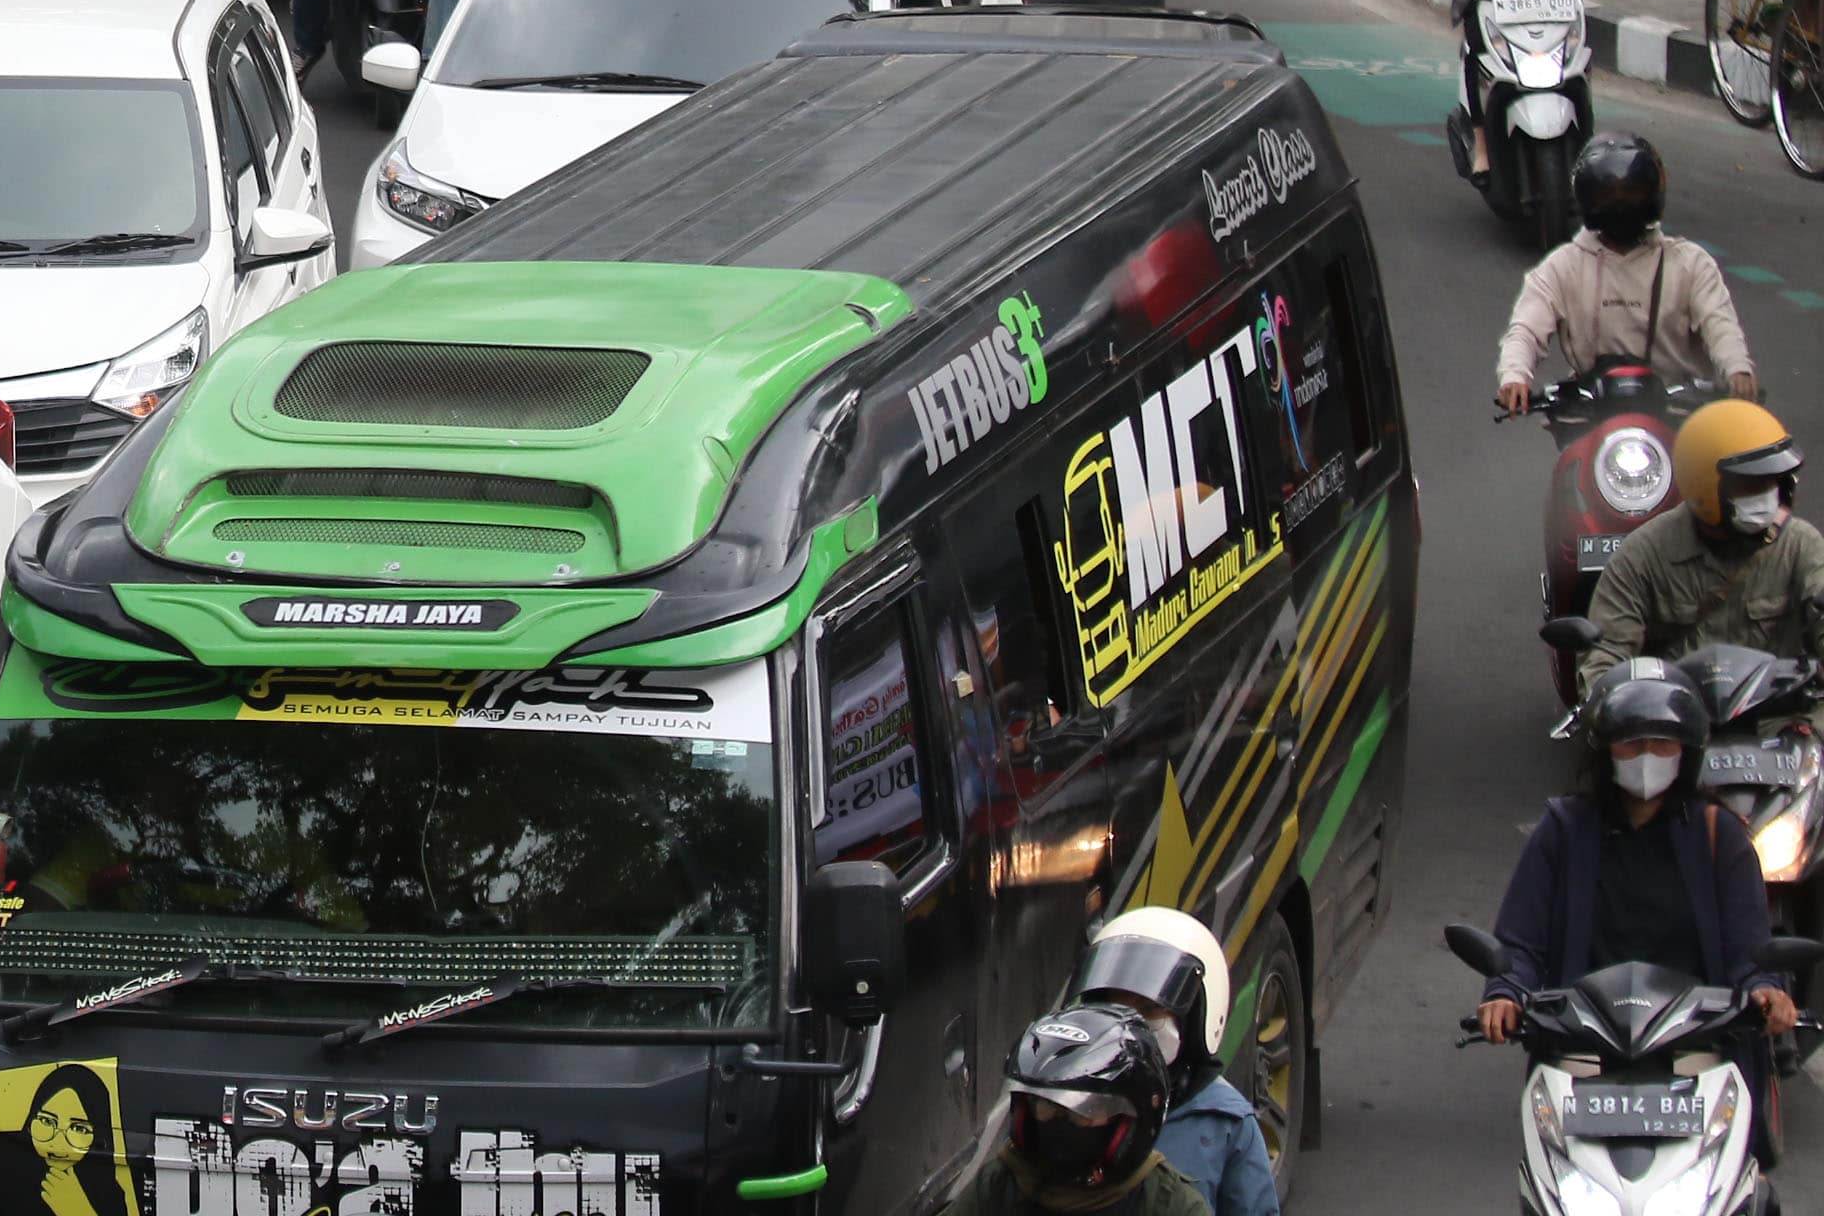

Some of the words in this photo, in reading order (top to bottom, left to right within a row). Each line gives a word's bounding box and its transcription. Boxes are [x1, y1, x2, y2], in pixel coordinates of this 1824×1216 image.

[1583, 539, 1593, 553] N
[274, 602, 407, 625] MARSHA
[412, 604, 482, 625] JAYA
[1135, 588, 1188, 659] Madura
[284, 703, 383, 717] SEMUGA
[395, 706, 505, 721] SELAMAT
[512, 710, 608, 725] SAMPAY
[615, 715, 712, 730] TUJUAN
[222, 1085, 441, 1135] ISUZU
[1564, 1097, 1576, 1114] N
[1588, 1095, 1645, 1115] 3814
